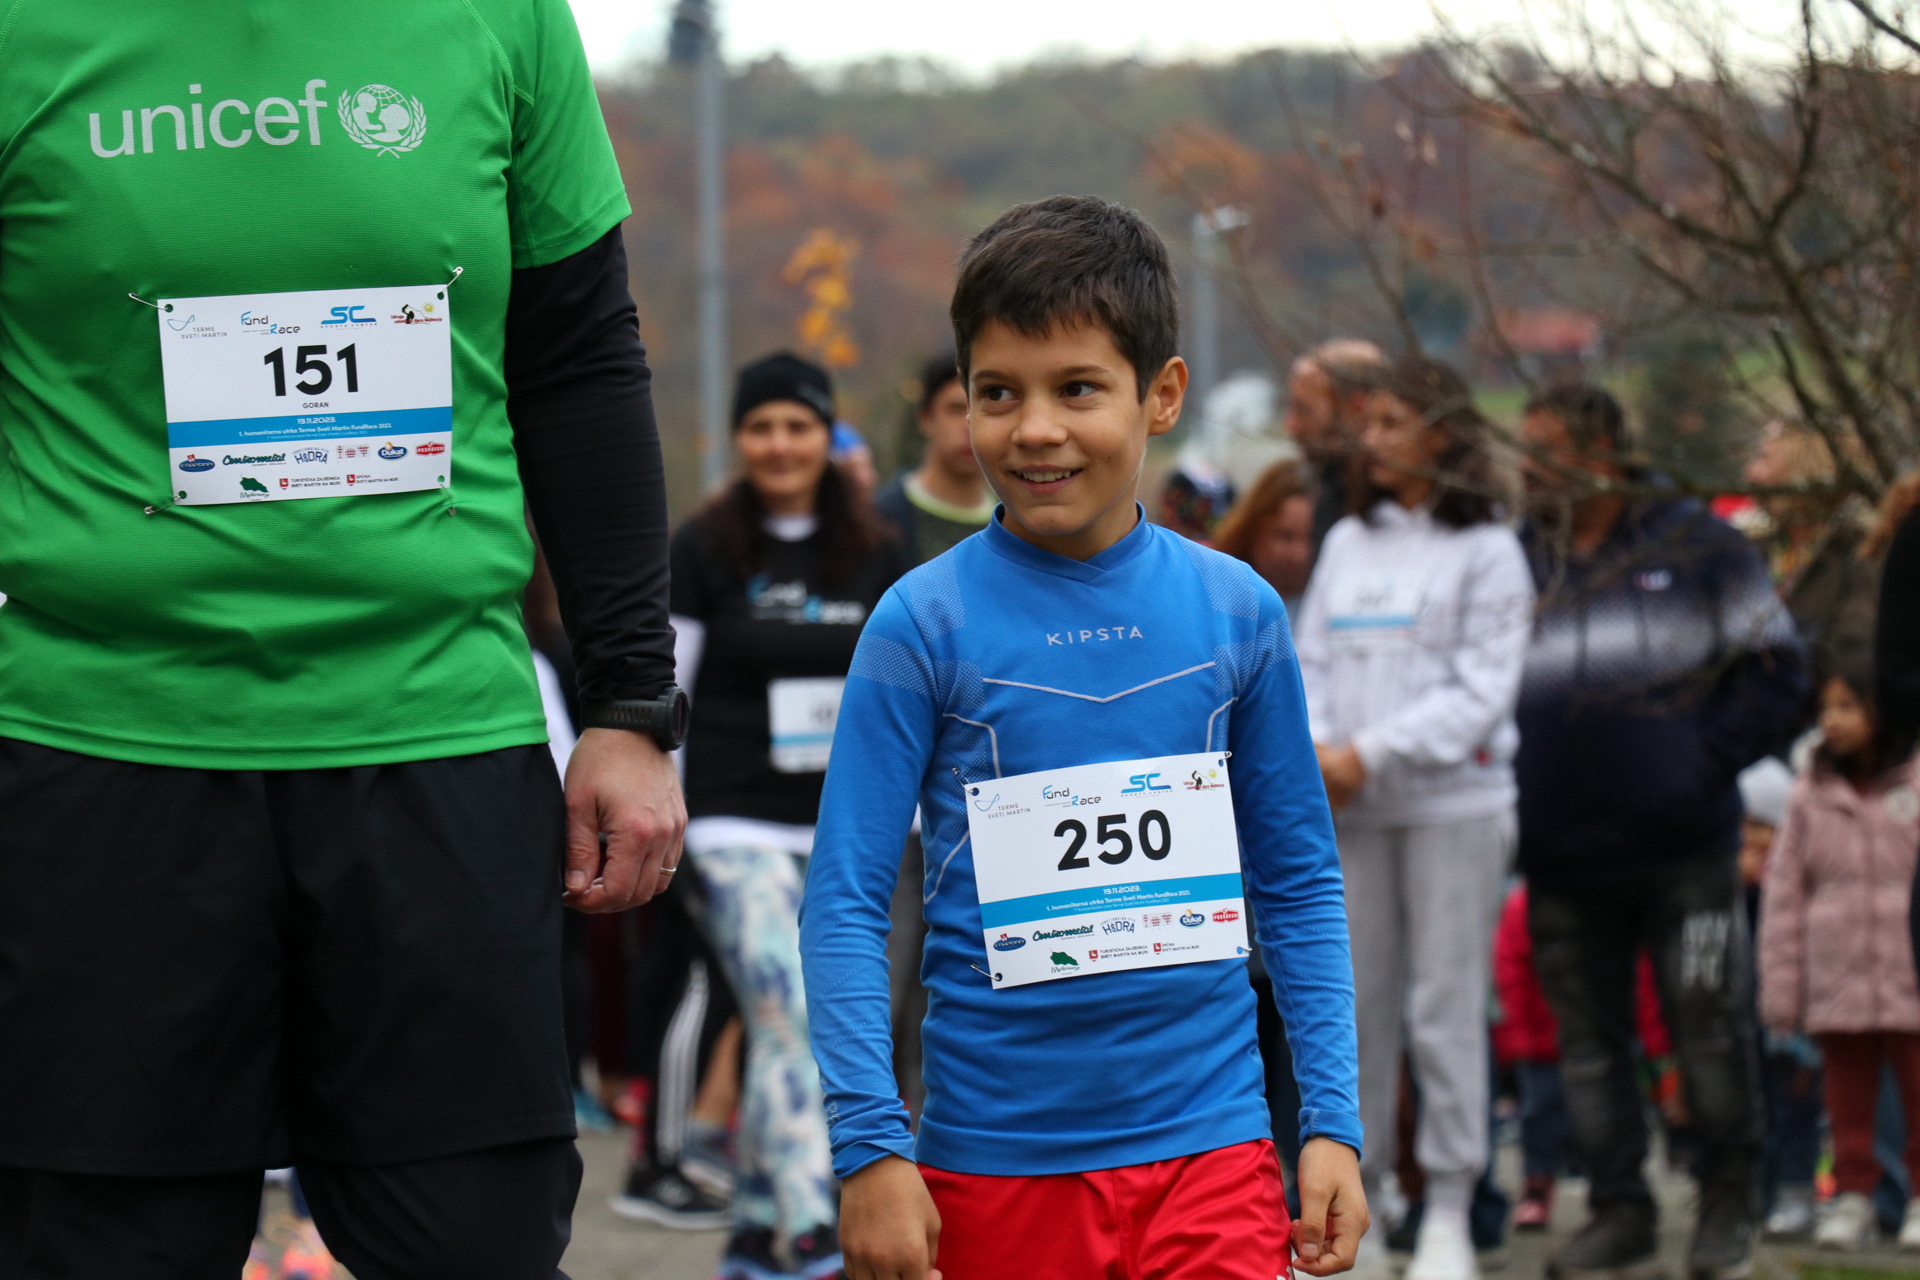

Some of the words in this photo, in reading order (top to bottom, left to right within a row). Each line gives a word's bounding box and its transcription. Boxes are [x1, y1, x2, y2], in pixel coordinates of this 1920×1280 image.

[89, 78, 328, 159] unicef
[241, 311, 269, 326] Fund
[269, 323, 301, 335] Race
[264, 343, 359, 397] 151
[302, 401, 330, 410] GORAN
[297, 416, 336, 425] 19.11.2023.
[331, 424, 351, 432] Martin
[381, 448, 405, 457] Dukat
[1046, 625, 1144, 647] KIPSTA
[1042, 784, 1070, 800] Fund
[997, 802, 1019, 811] TERME
[1071, 795, 1102, 807] Race
[987, 812, 1005, 820] SVETI
[1006, 807, 1031, 816] MARTIN
[1054, 809, 1171, 871] 250
[1103, 885, 1141, 895] 19.11.2023.
[1104, 896, 1123, 904] Terme
[1123, 895, 1136, 903] Sveti
[1137, 893, 1154, 901] Martin
[1182, 915, 1203, 925] Dukat
